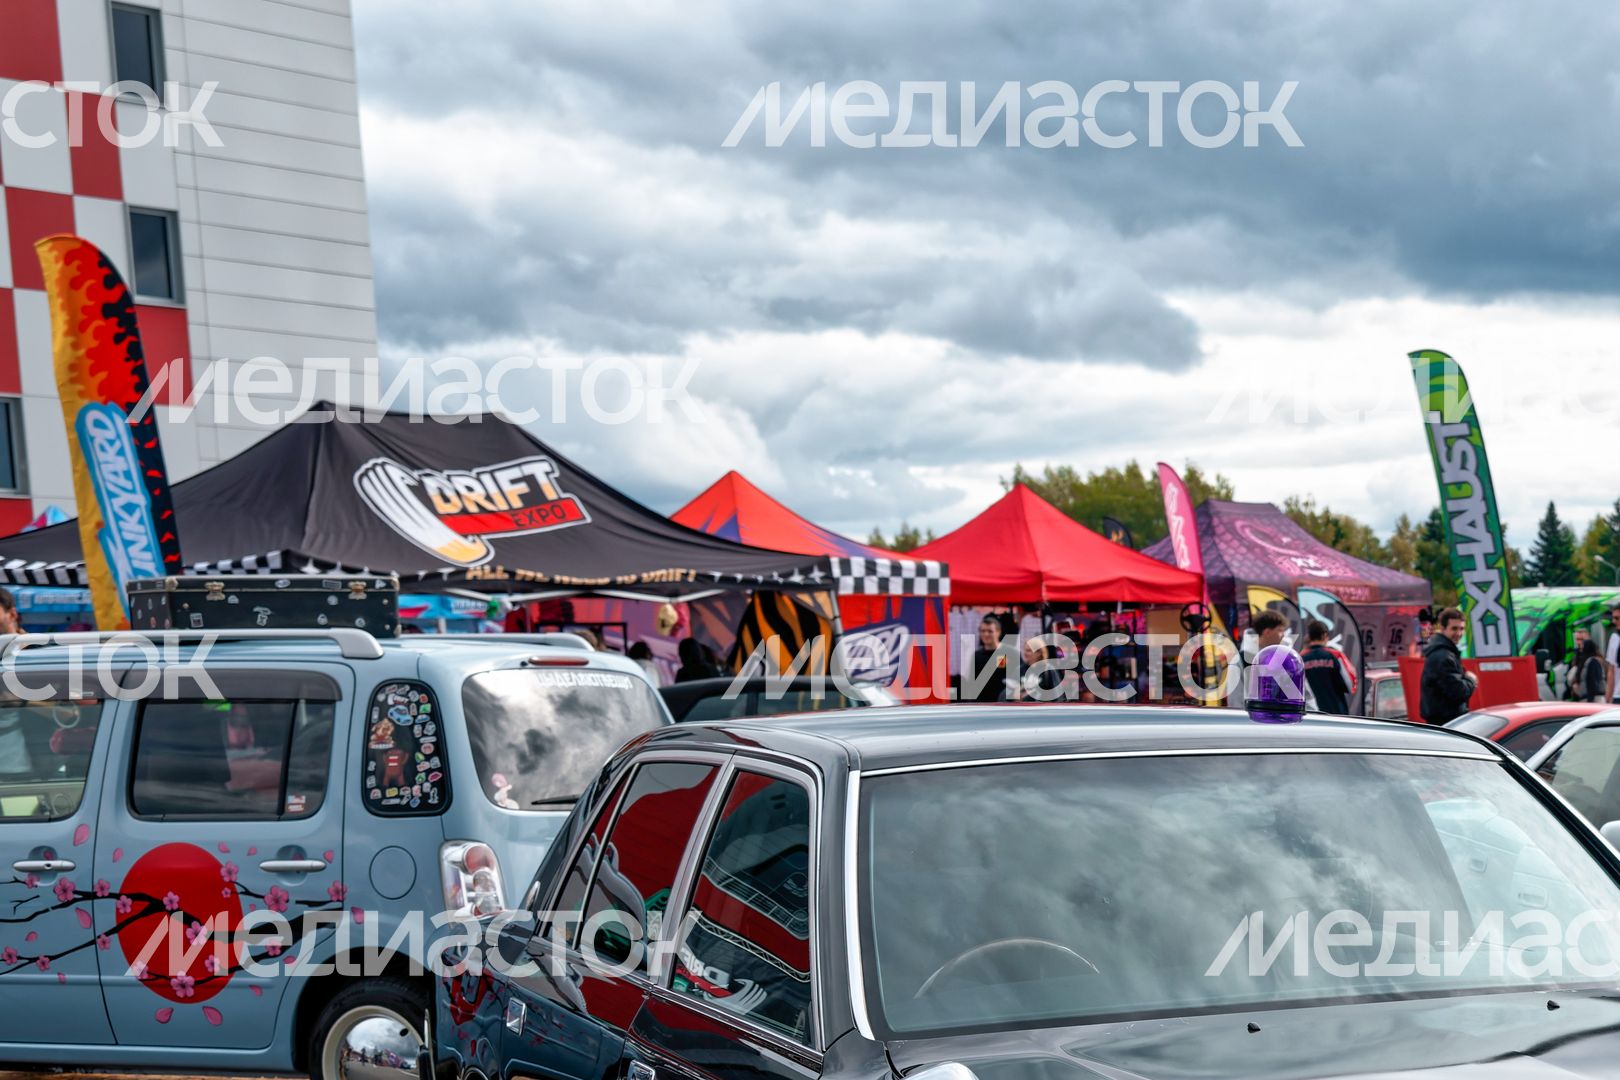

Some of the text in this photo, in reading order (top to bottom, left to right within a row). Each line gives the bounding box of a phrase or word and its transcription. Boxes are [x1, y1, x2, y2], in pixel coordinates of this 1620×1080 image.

[421, 460, 558, 515] DRIFT
[513, 504, 567, 528] EXPO
[1424, 410, 1512, 658] EXHAUST
